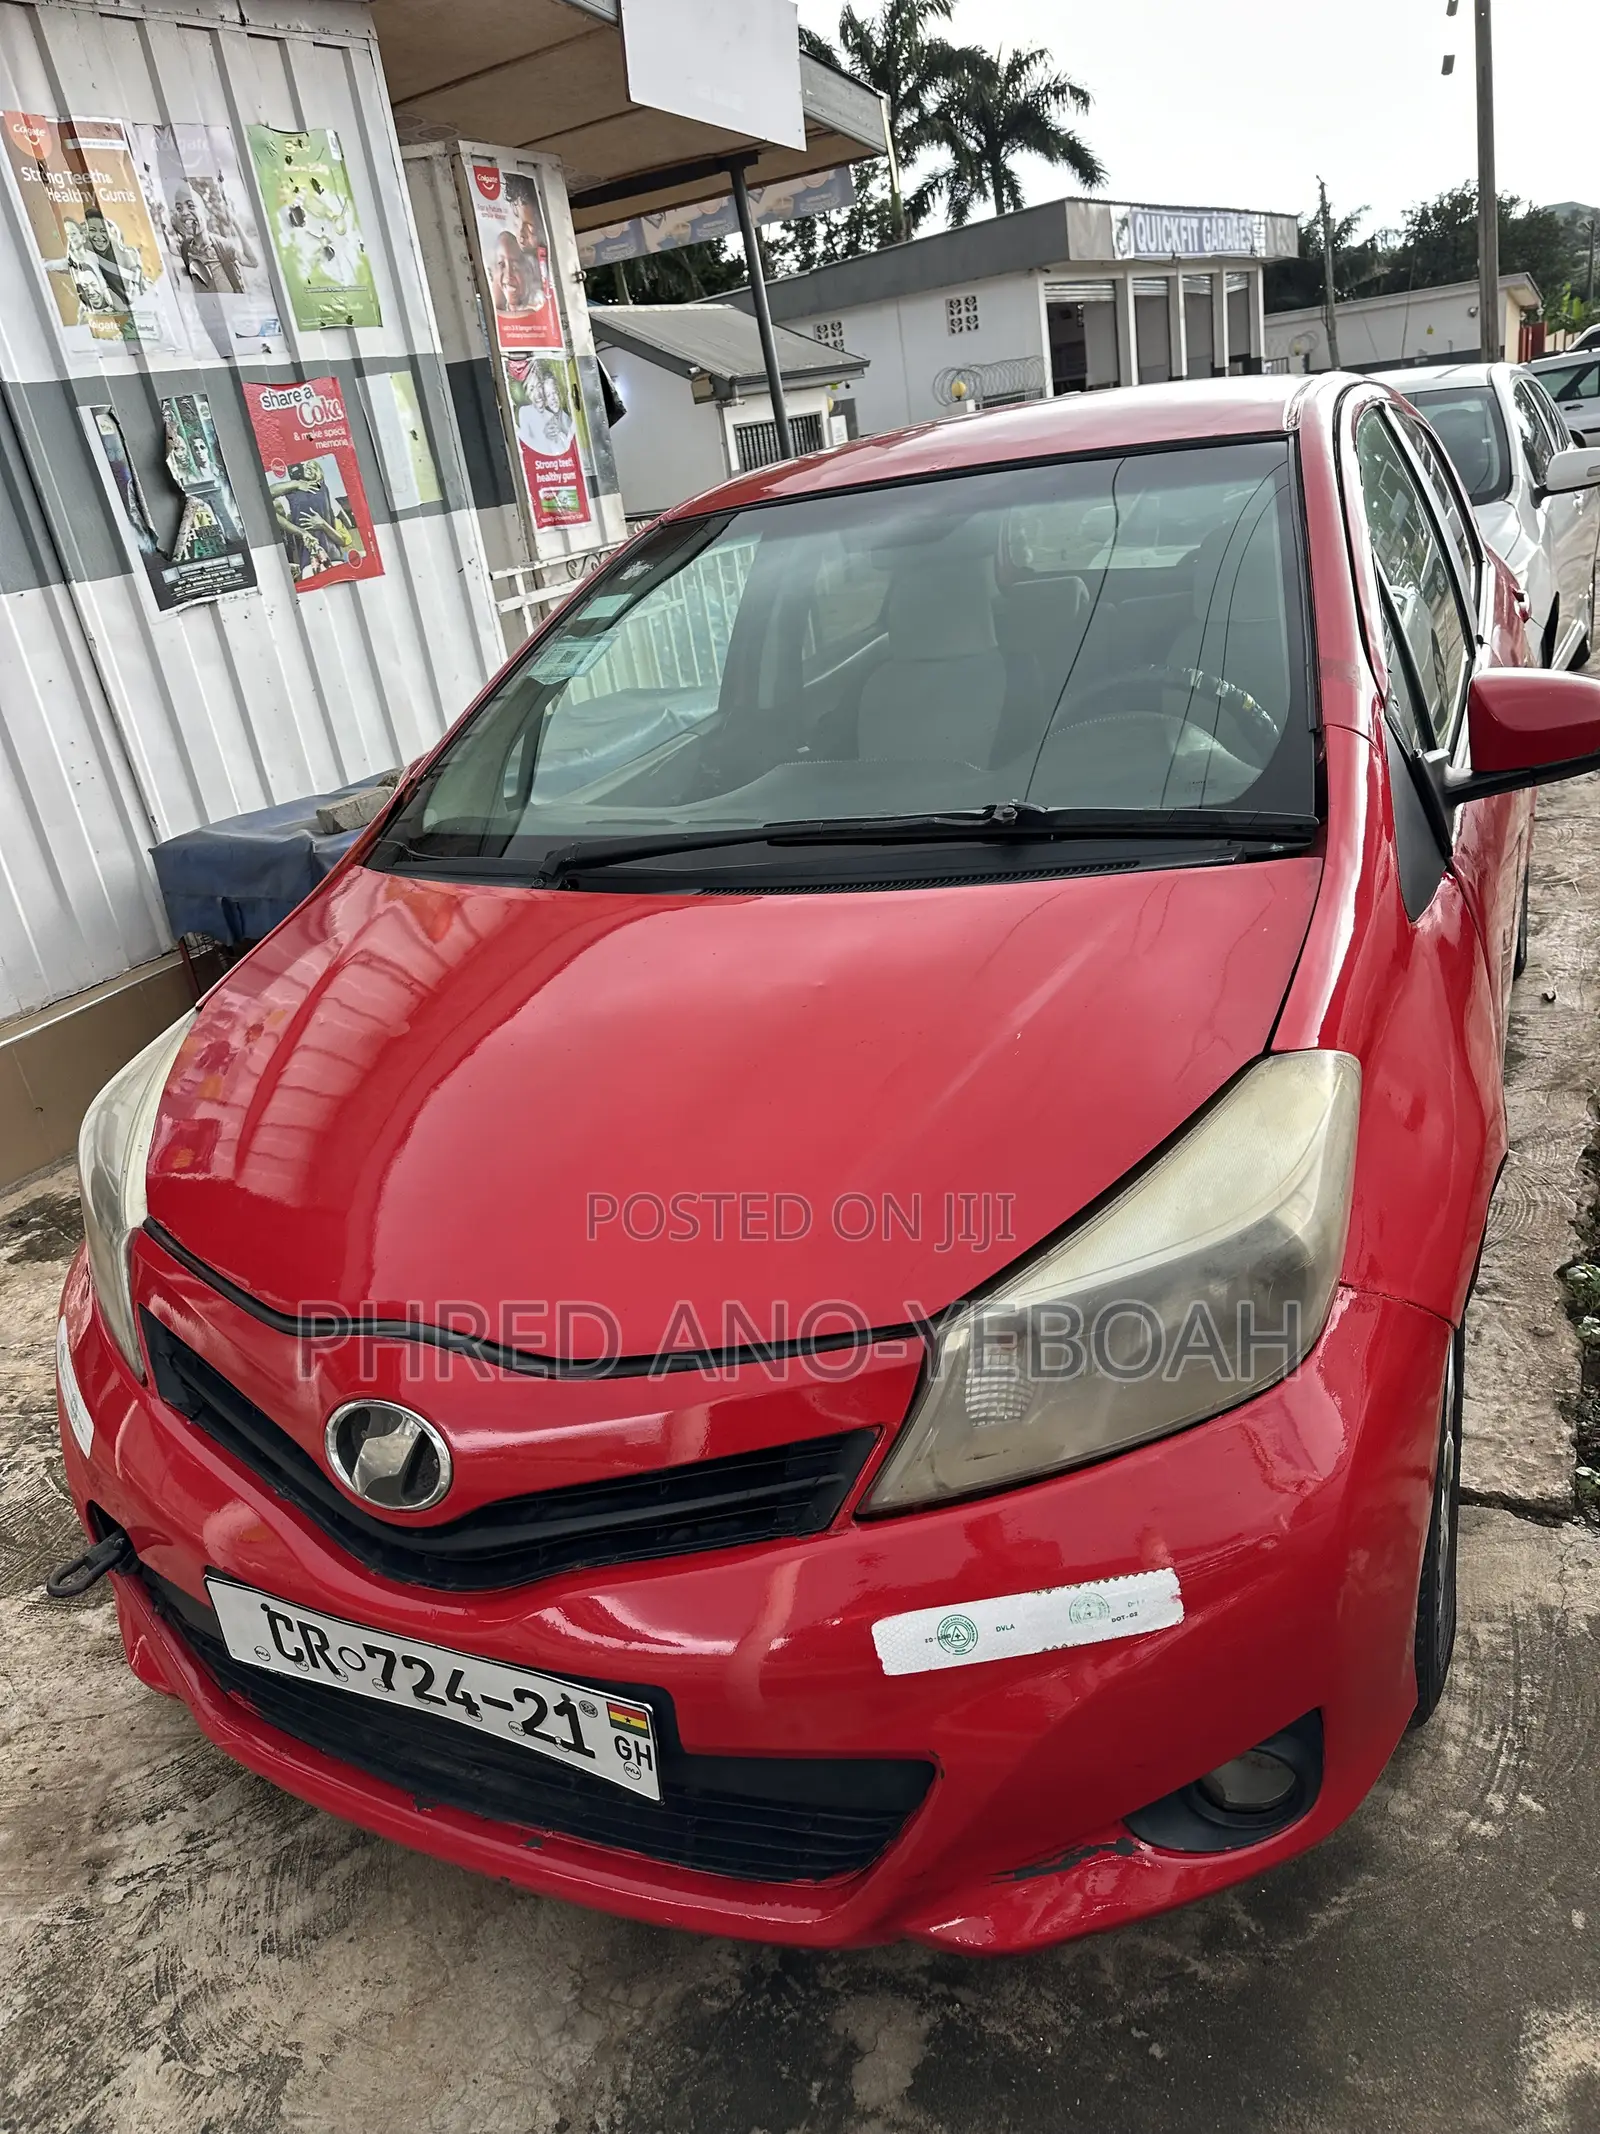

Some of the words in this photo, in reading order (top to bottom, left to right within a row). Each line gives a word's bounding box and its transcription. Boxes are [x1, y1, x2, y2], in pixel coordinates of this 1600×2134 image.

[63, 168, 104, 184] Teeth
[477, 173, 499, 183] Colgate
[46, 187, 97, 206] Healthy
[99, 187, 137, 202] Gums
[1135, 213, 1199, 252] QUICKFIT
[1202, 214, 1254, 252] GARAGES
[261, 390, 303, 409] share
[303, 386, 314, 399] a
[298, 397, 343, 427] Coke
[293, 432, 301, 441] &
[535, 459, 559, 471] Strong
[536, 471, 562, 484] healthy
[995, 1623, 1015, 1633] DVLA
[266, 1609, 341, 1675] CR
[362, 1642, 596, 1759] 724-21
[614, 1735, 653, 1771] GH
